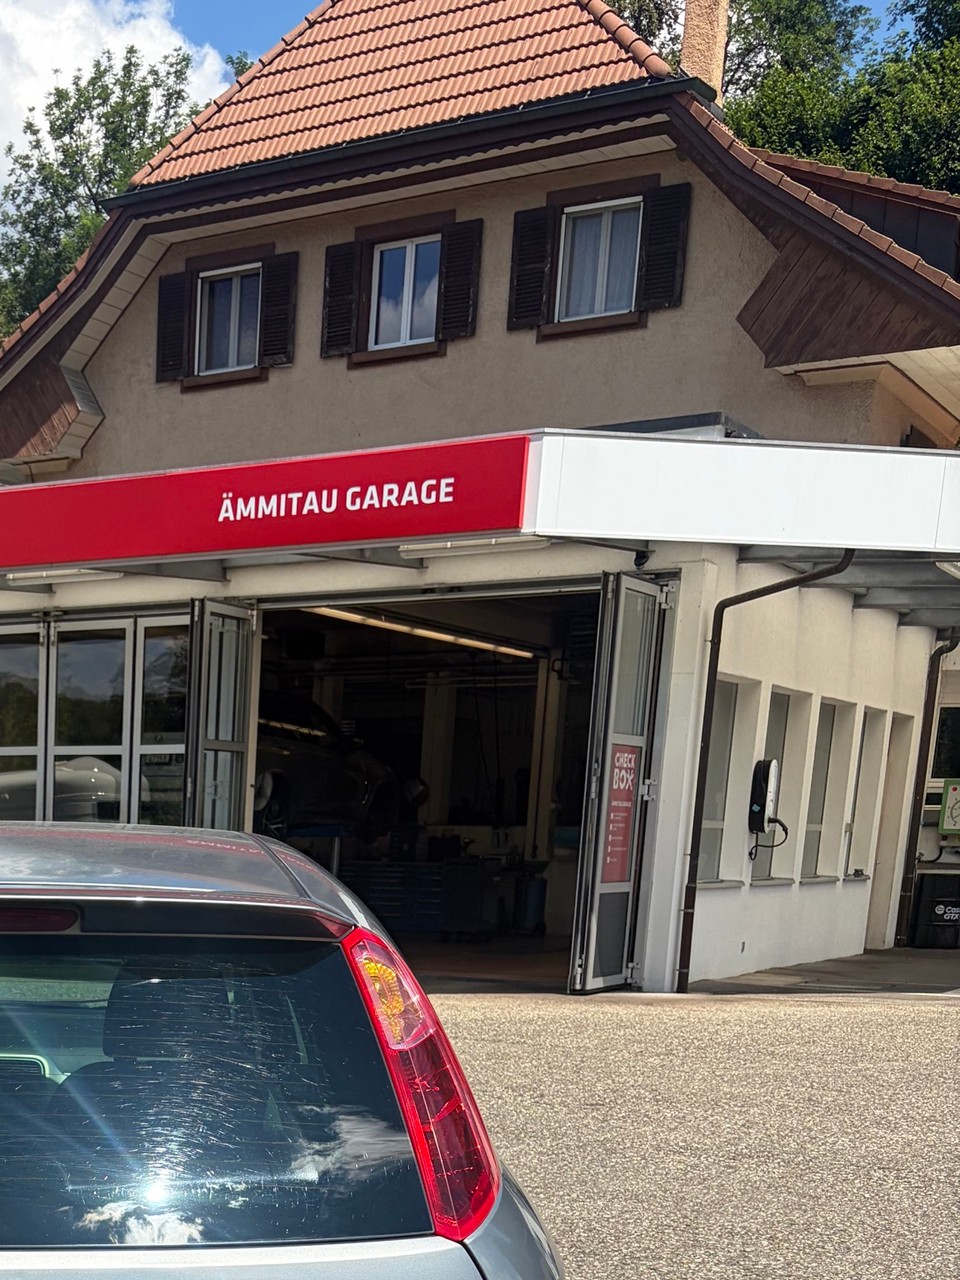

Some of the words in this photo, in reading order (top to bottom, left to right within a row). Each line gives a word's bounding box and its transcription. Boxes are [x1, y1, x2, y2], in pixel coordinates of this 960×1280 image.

[218, 489, 338, 522] ÄMMITAU
[345, 477, 455, 511] GARAGE
[614, 752, 637, 768] CHECK
[612, 767, 636, 791] BOX
